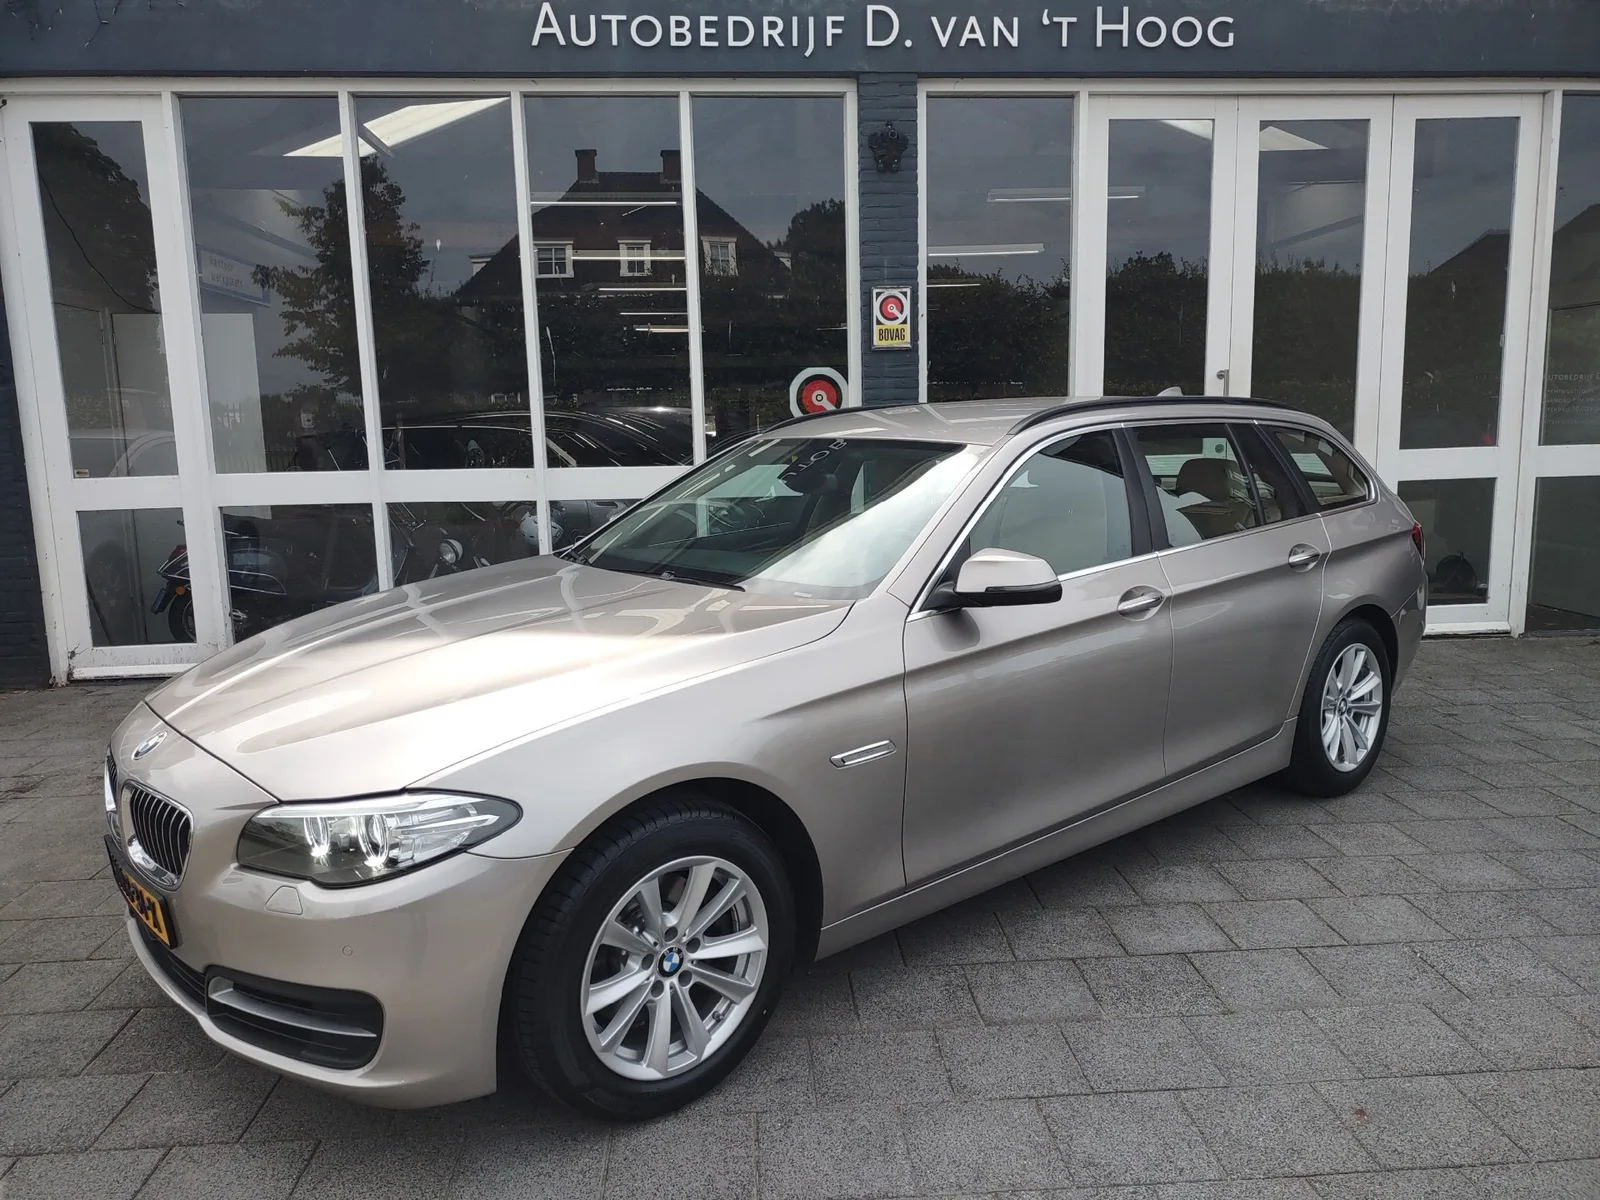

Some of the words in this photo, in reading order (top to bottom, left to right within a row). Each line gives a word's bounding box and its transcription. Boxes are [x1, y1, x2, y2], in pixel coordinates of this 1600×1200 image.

[531, 2, 845, 58] AUTOBEDRIJF
[866, 4, 913, 48] D.
[930, 16, 1019, 48] VAN
[1096, 6, 1235, 48] HOOG
[878, 327, 906, 342] BOVAG
